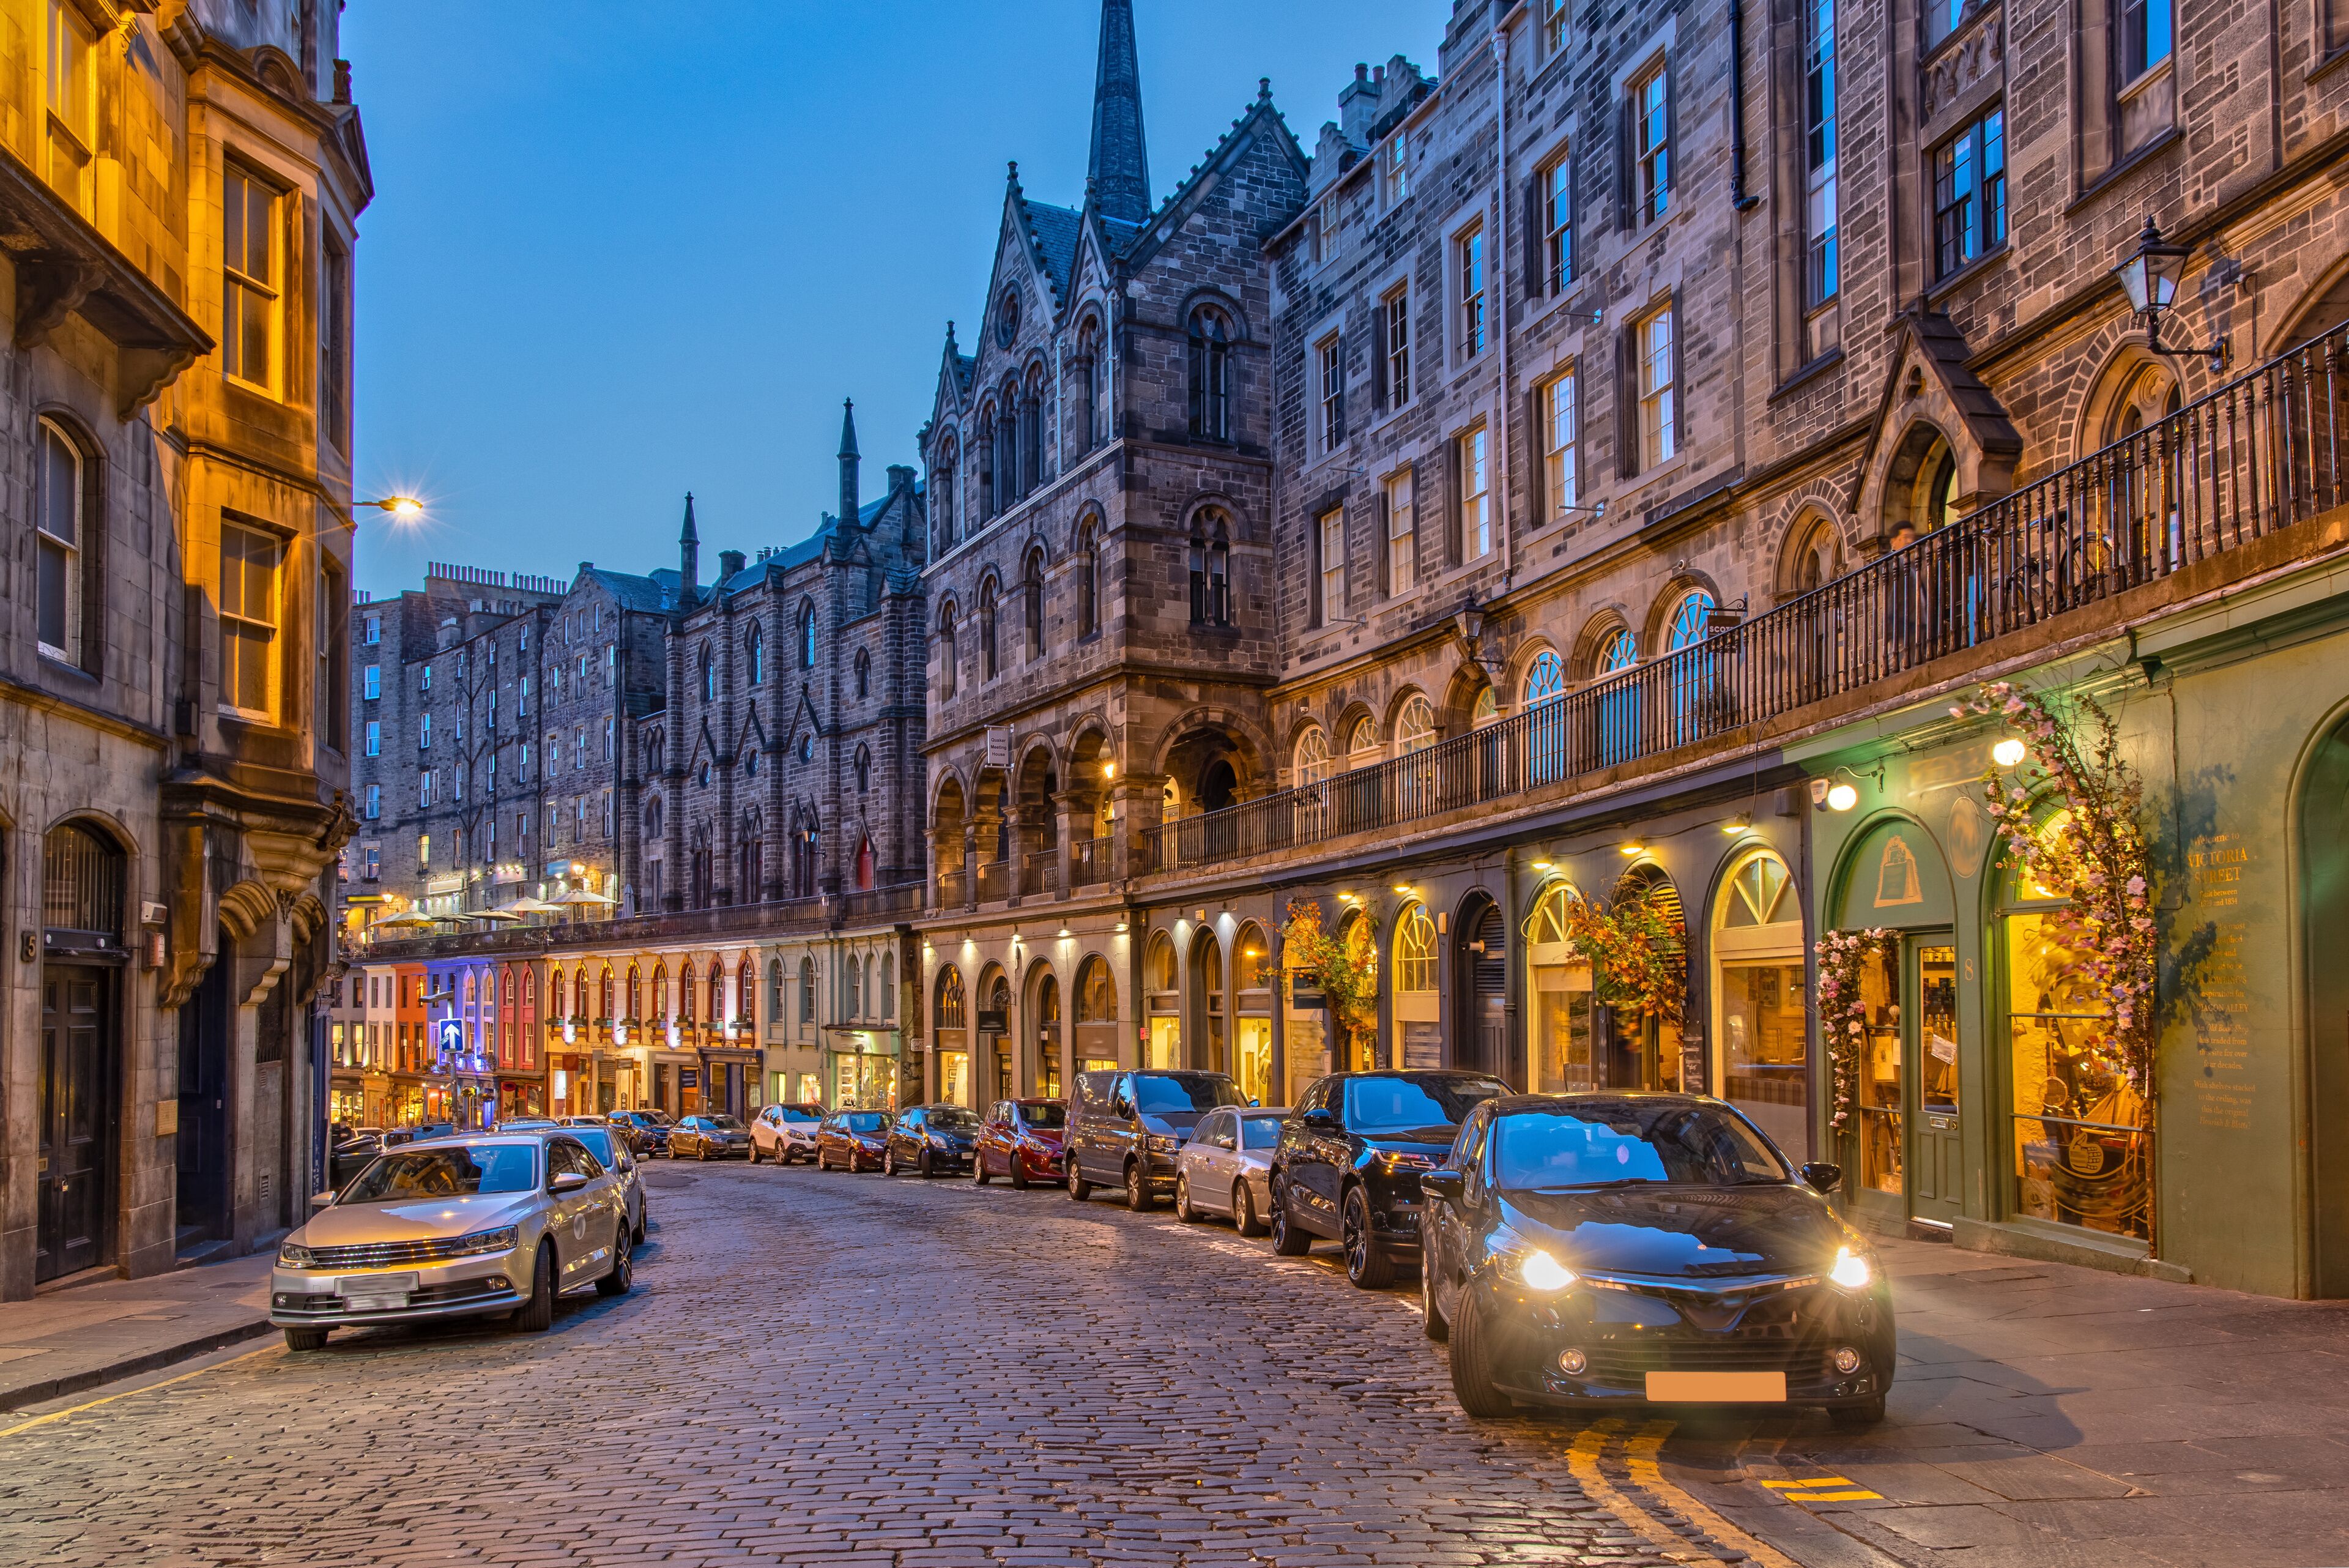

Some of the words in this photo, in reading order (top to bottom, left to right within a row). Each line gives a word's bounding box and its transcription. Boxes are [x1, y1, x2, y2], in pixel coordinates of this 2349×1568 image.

[2194, 833, 2229, 845] Welcome
[2188, 847, 2248, 868] VICTORIA
[2194, 867, 2242, 885] STREET
[28, 935, 36, 957] 5
[2224, 948, 2237, 957] and
[1965, 958, 1973, 981] 8
[2226, 1003, 2249, 1012] ALLEY
[2206, 1023, 2217, 1031] Old
[2232, 1037, 2247, 1046] from
[2194, 1079, 2208, 1089] With
[2209, 1081, 2231, 1090] shelves
[2232, 1083, 2256, 1092] stacked
[2205, 1093, 2215, 1101] the
[2213, 1105, 2224, 1114] the
[2224, 1108, 2249, 1118] original
